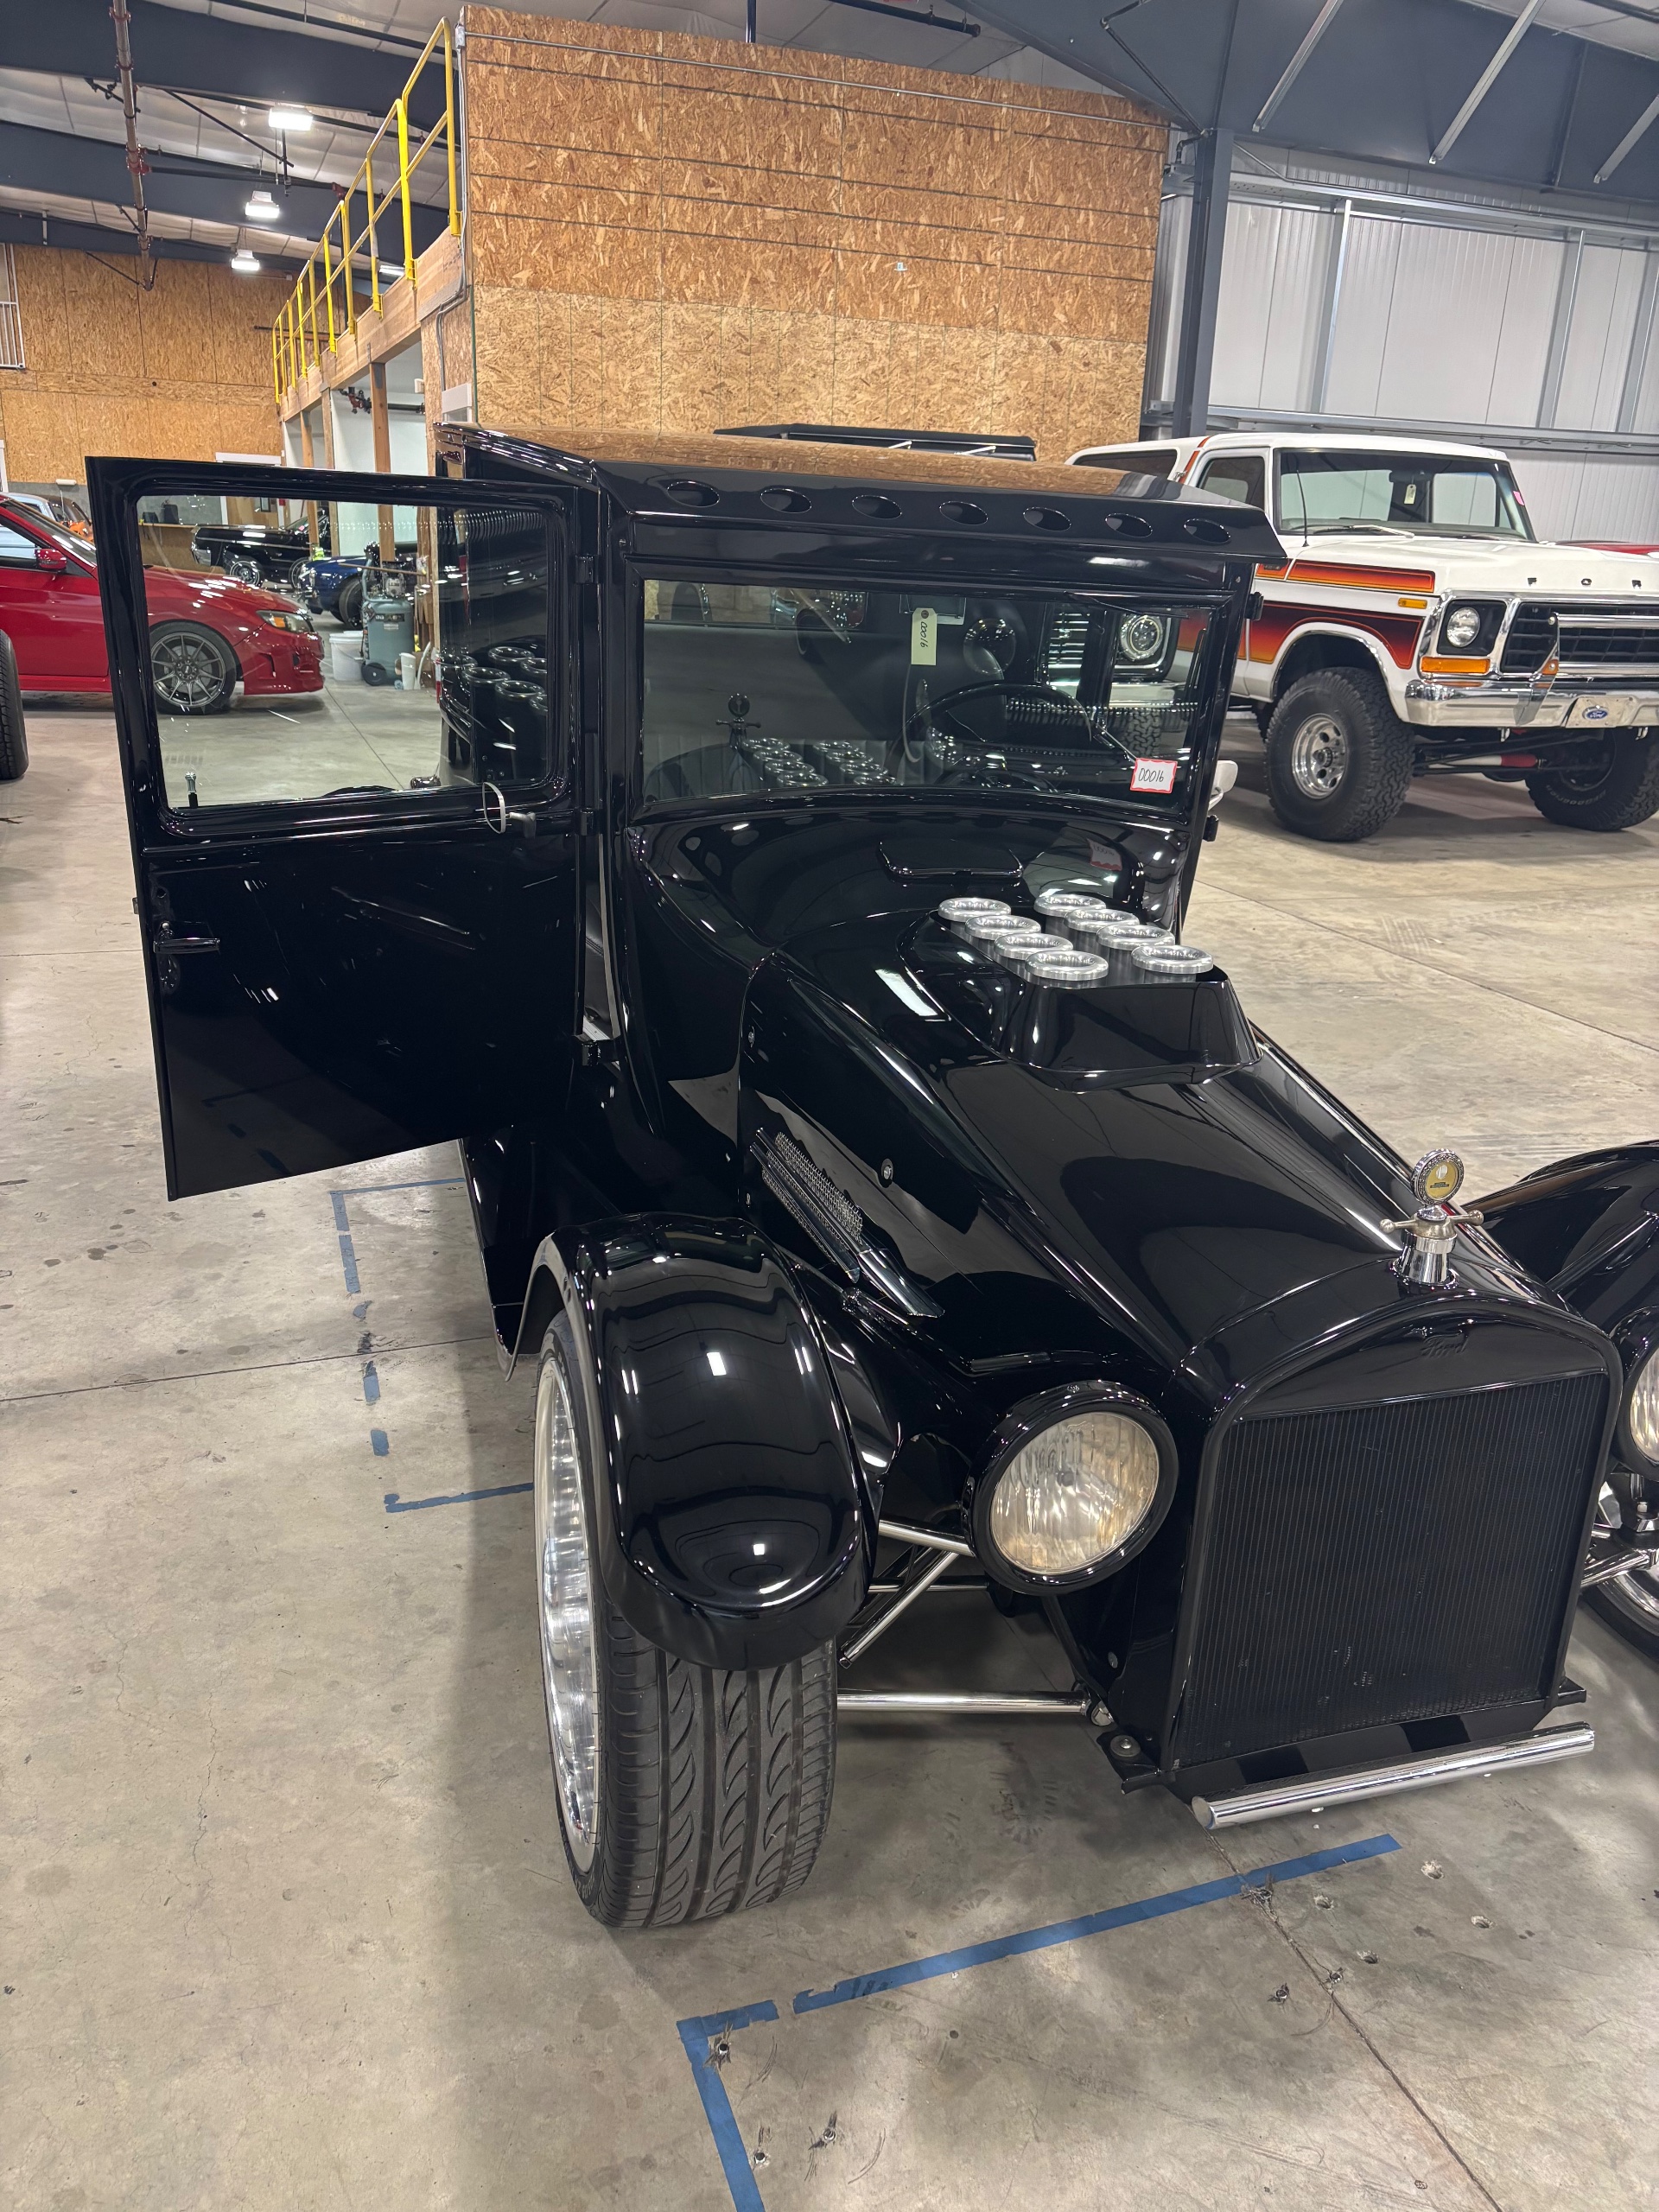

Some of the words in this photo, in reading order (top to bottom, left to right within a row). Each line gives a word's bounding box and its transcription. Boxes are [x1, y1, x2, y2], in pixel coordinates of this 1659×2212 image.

[919, 621, 929, 648] 00016
[1138, 767, 1165, 783] 00016
[1420, 1333, 1470, 1358] Ford
